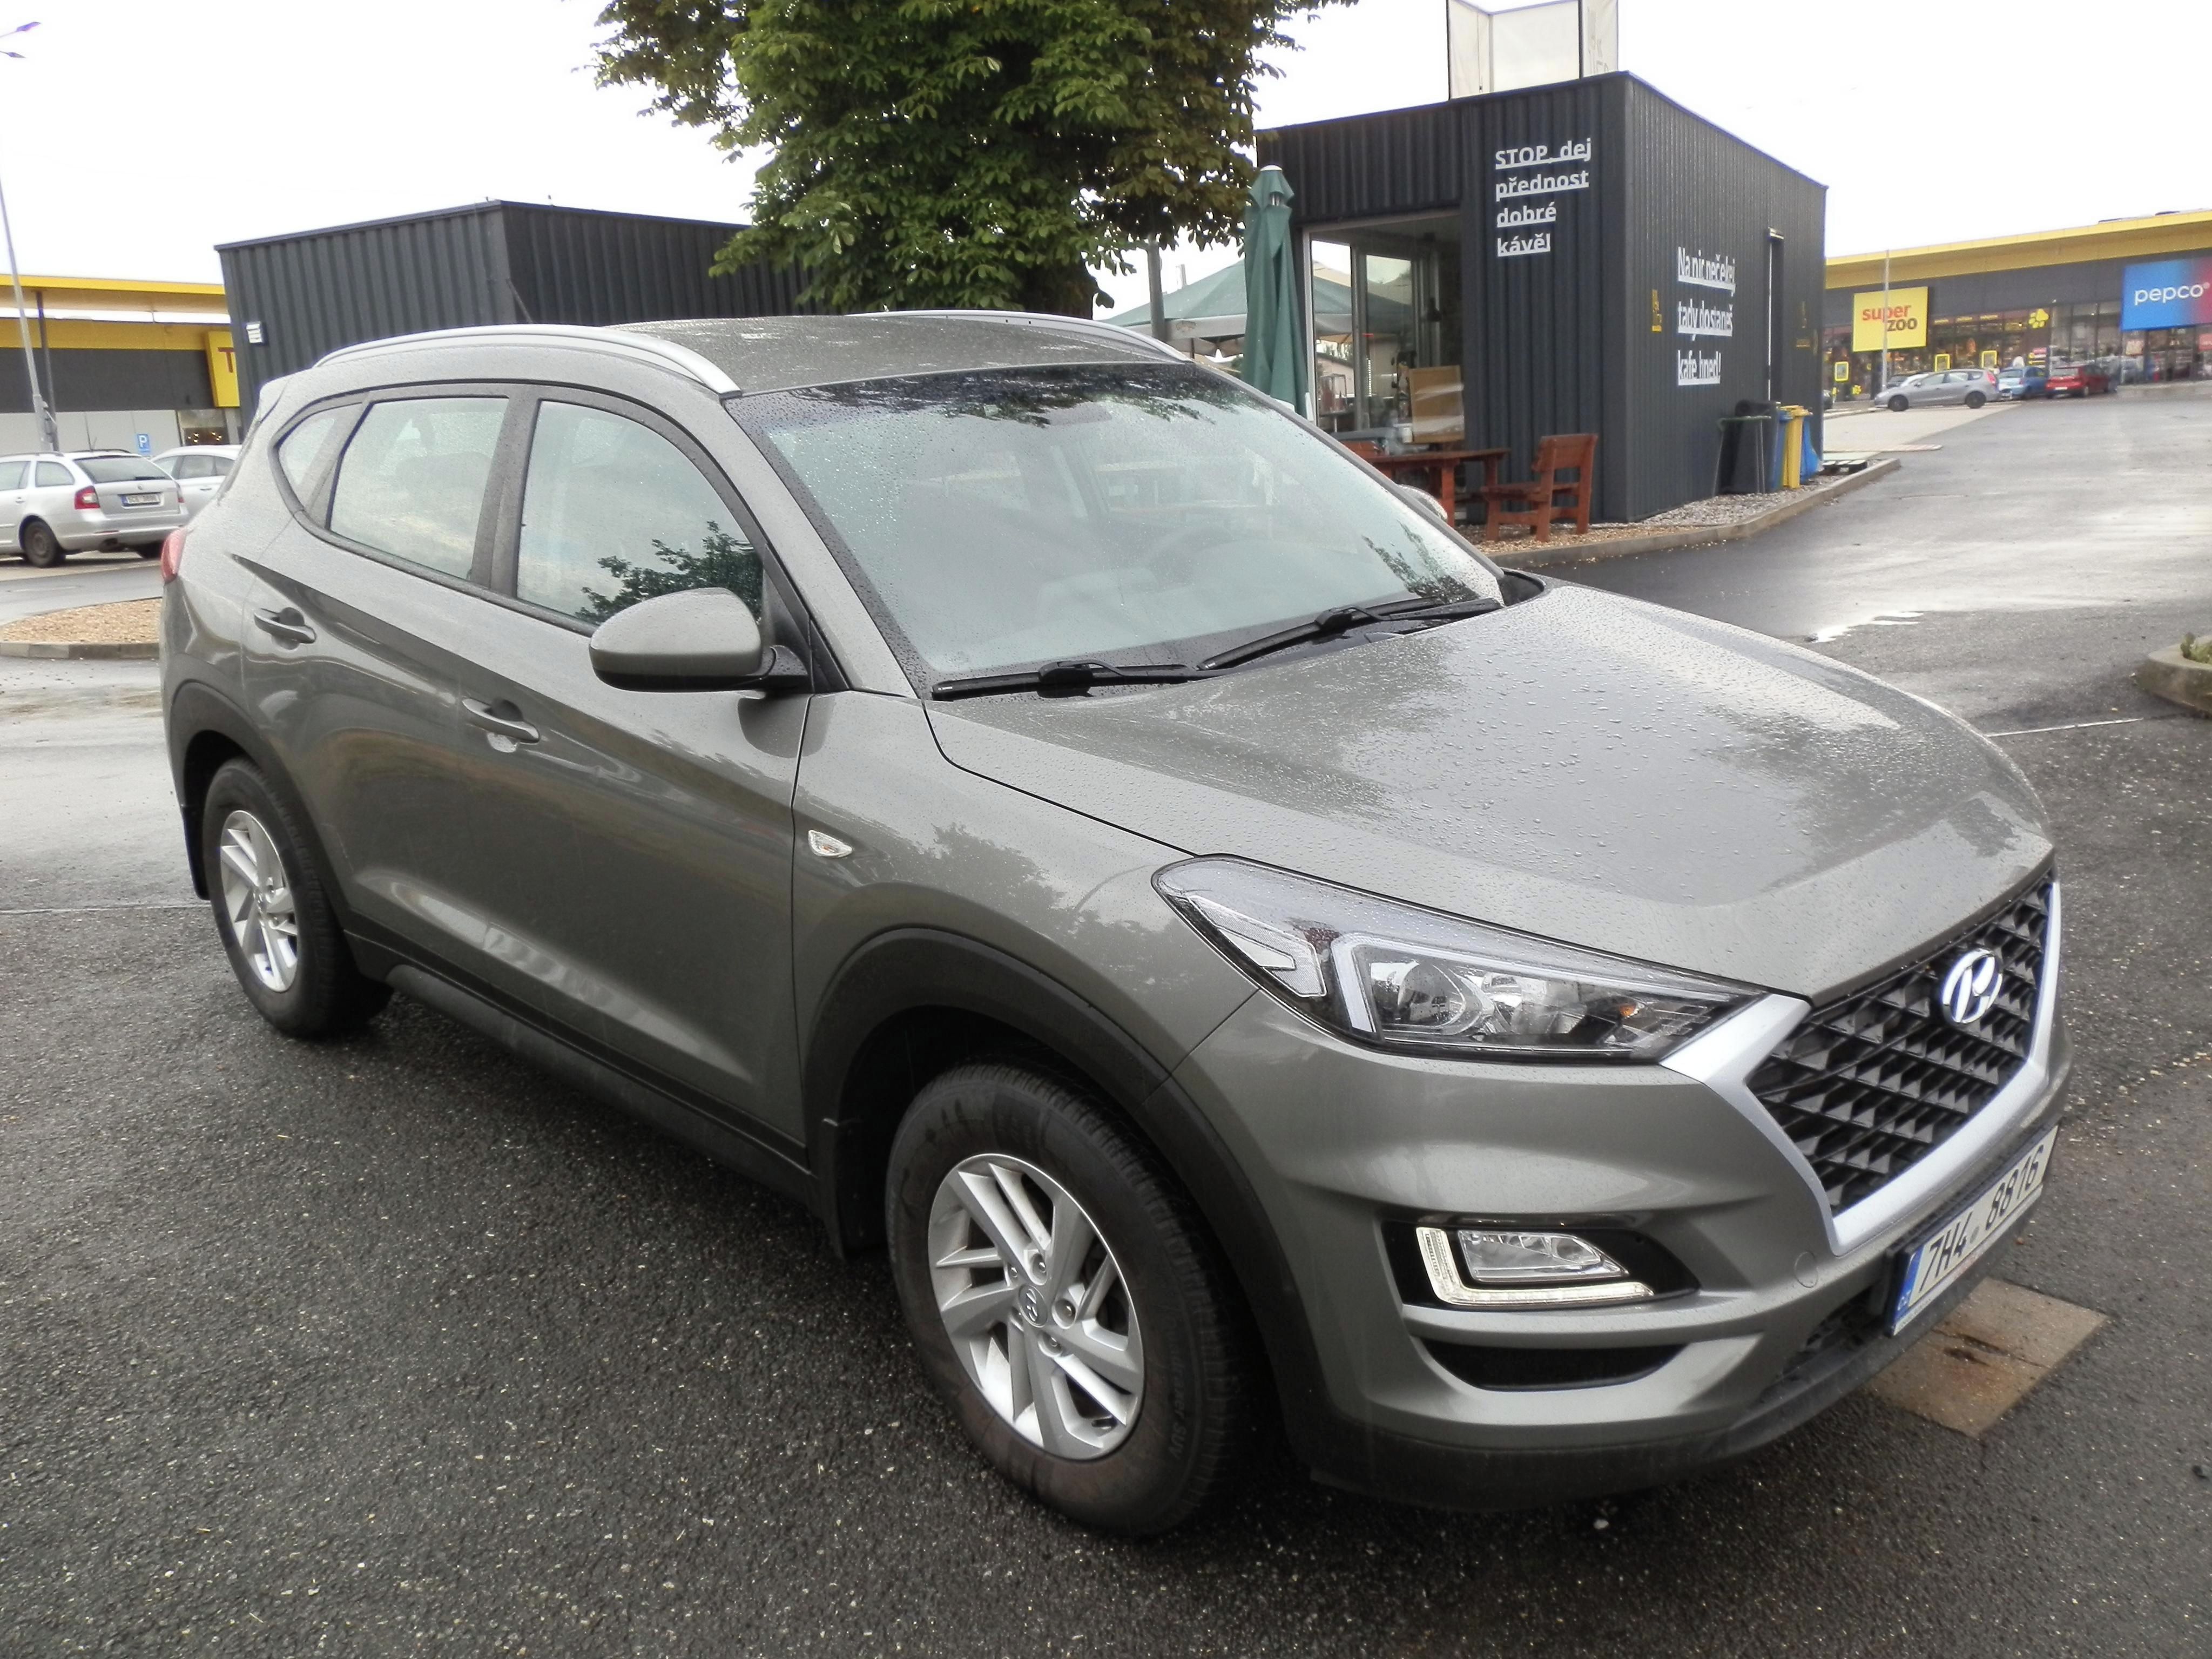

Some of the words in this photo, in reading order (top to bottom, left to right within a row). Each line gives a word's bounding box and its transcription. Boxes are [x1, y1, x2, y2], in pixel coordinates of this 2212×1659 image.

[1560, 138, 1591, 161] dej
[1496, 171, 1589, 202] přednost
[1497, 201, 1556, 227] dobré
[1678, 246, 1690, 283] Na
[2134, 284, 2203, 306] pepco
[1678, 298, 1698, 341] tady
[1887, 318, 1917, 332] zoo
[1678, 349, 1697, 386] kafe
[139, 435, 147, 448] P
[1918, 1210, 1974, 1292] 7H4
[1985, 1144, 2044, 1231] 8816
